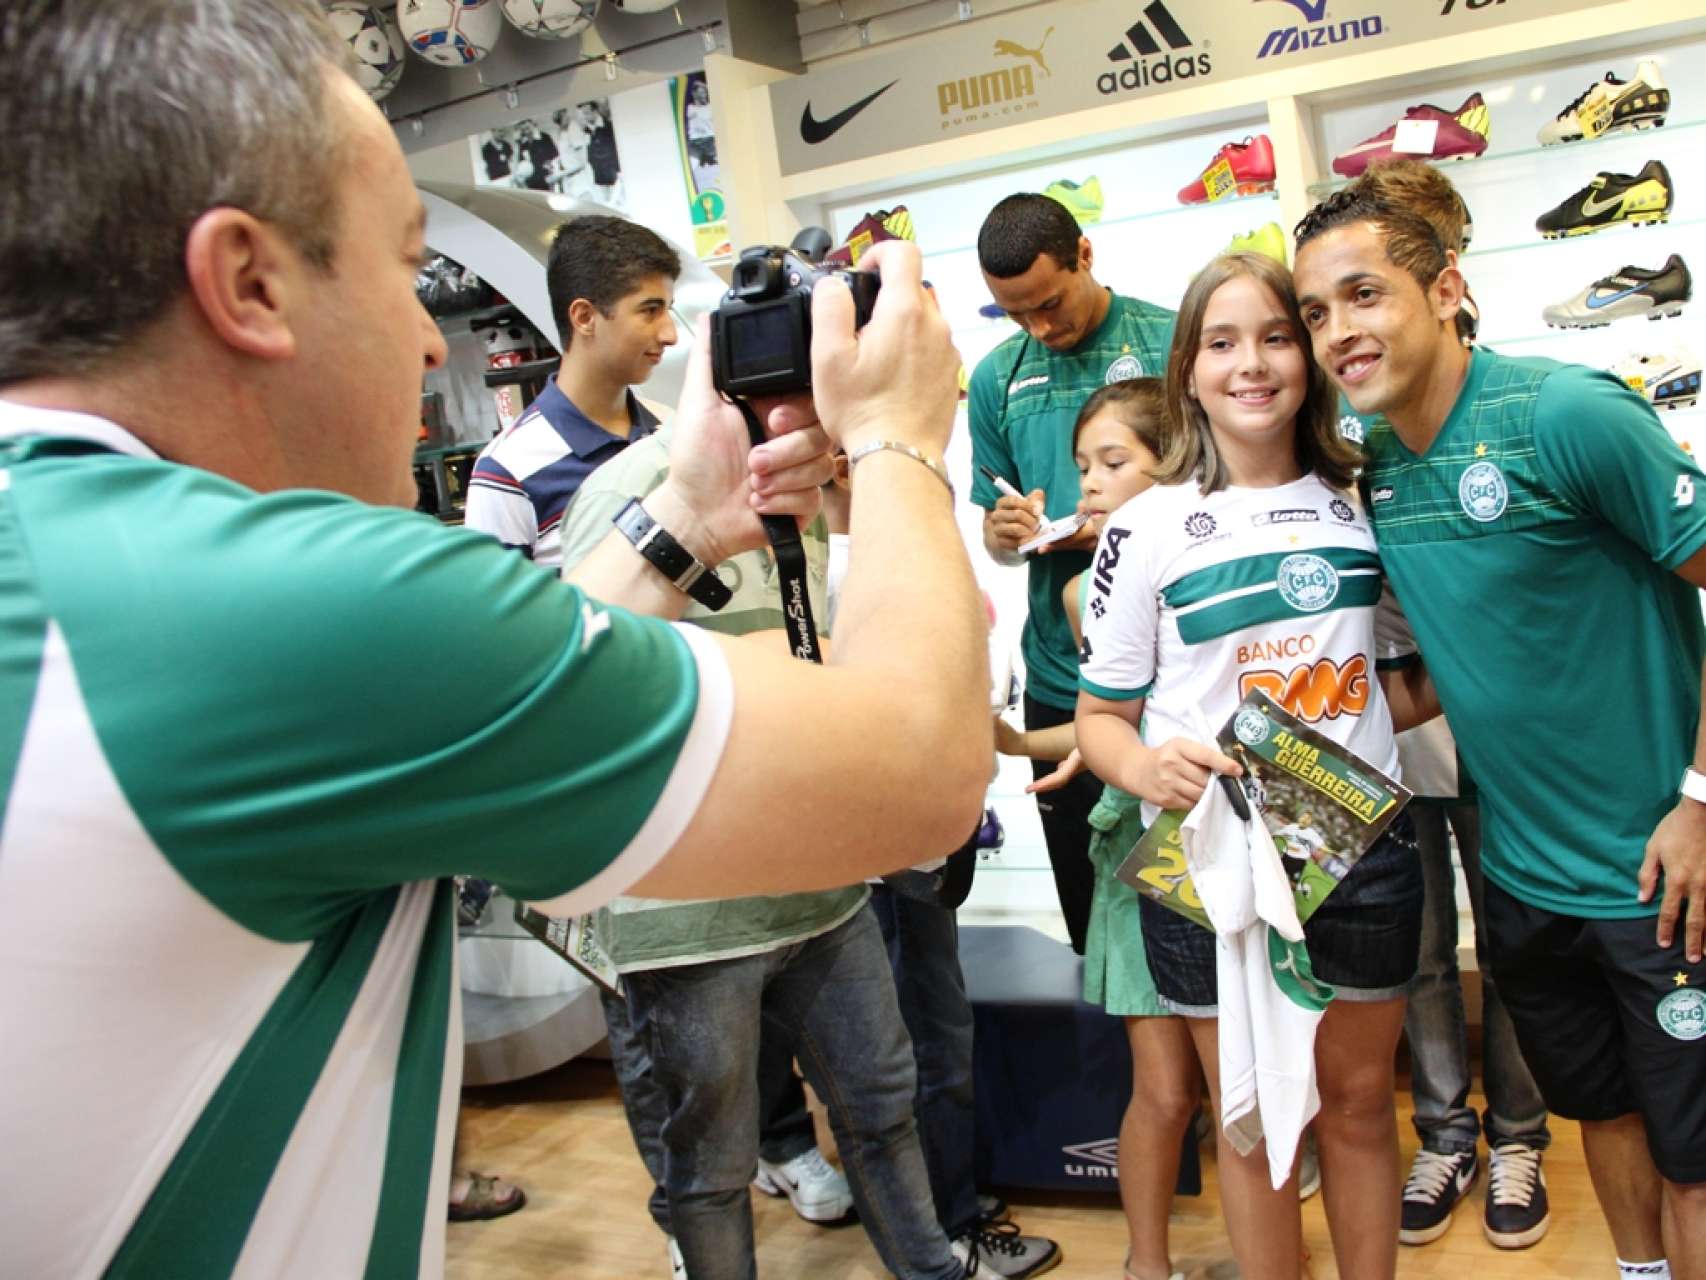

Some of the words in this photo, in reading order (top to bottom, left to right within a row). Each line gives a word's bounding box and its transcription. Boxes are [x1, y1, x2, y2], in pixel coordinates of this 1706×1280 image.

[1256, 15, 1383, 59] MIZUNO
[937, 64, 1036, 115] PUMA
[1097, 53, 1212, 95] adidas
[941, 100, 1040, 130] puma.com
[1237, 634, 1316, 664] BANCO
[1272, 731, 1321, 763] ALMA
[1275, 748, 1377, 817] GUERREIRA
